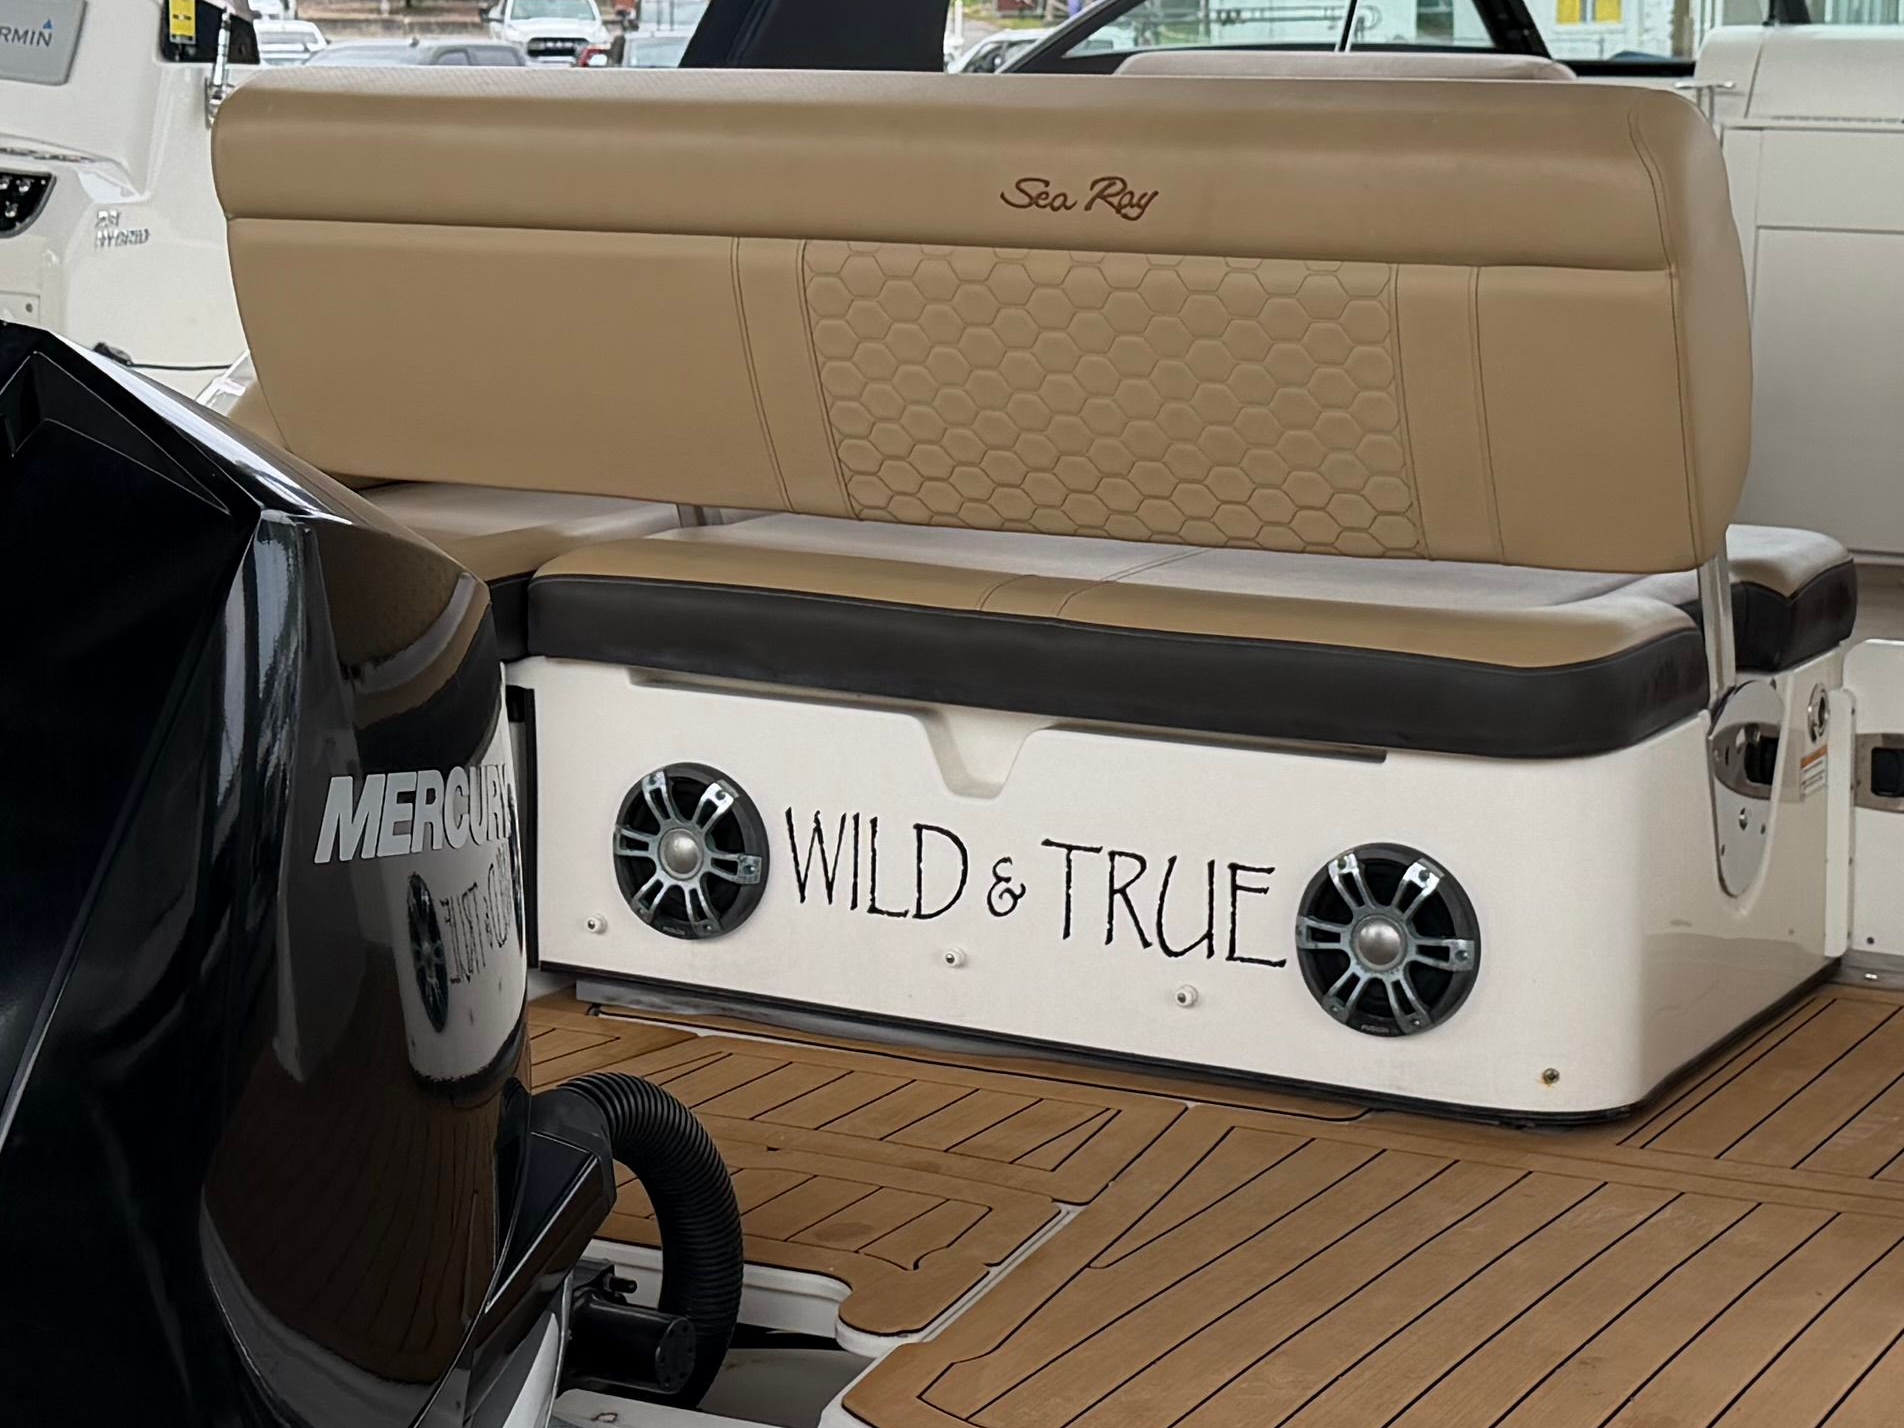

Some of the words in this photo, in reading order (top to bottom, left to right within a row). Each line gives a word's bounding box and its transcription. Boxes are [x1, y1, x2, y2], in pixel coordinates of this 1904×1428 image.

[999, 176, 1078, 213] Sea
[1083, 175, 1160, 222] Ray
[313, 762, 511, 865] MERCURY
[784, 806, 970, 921] WILD
[986, 855, 1027, 918] &
[1040, 837, 1288, 969] TRUE
